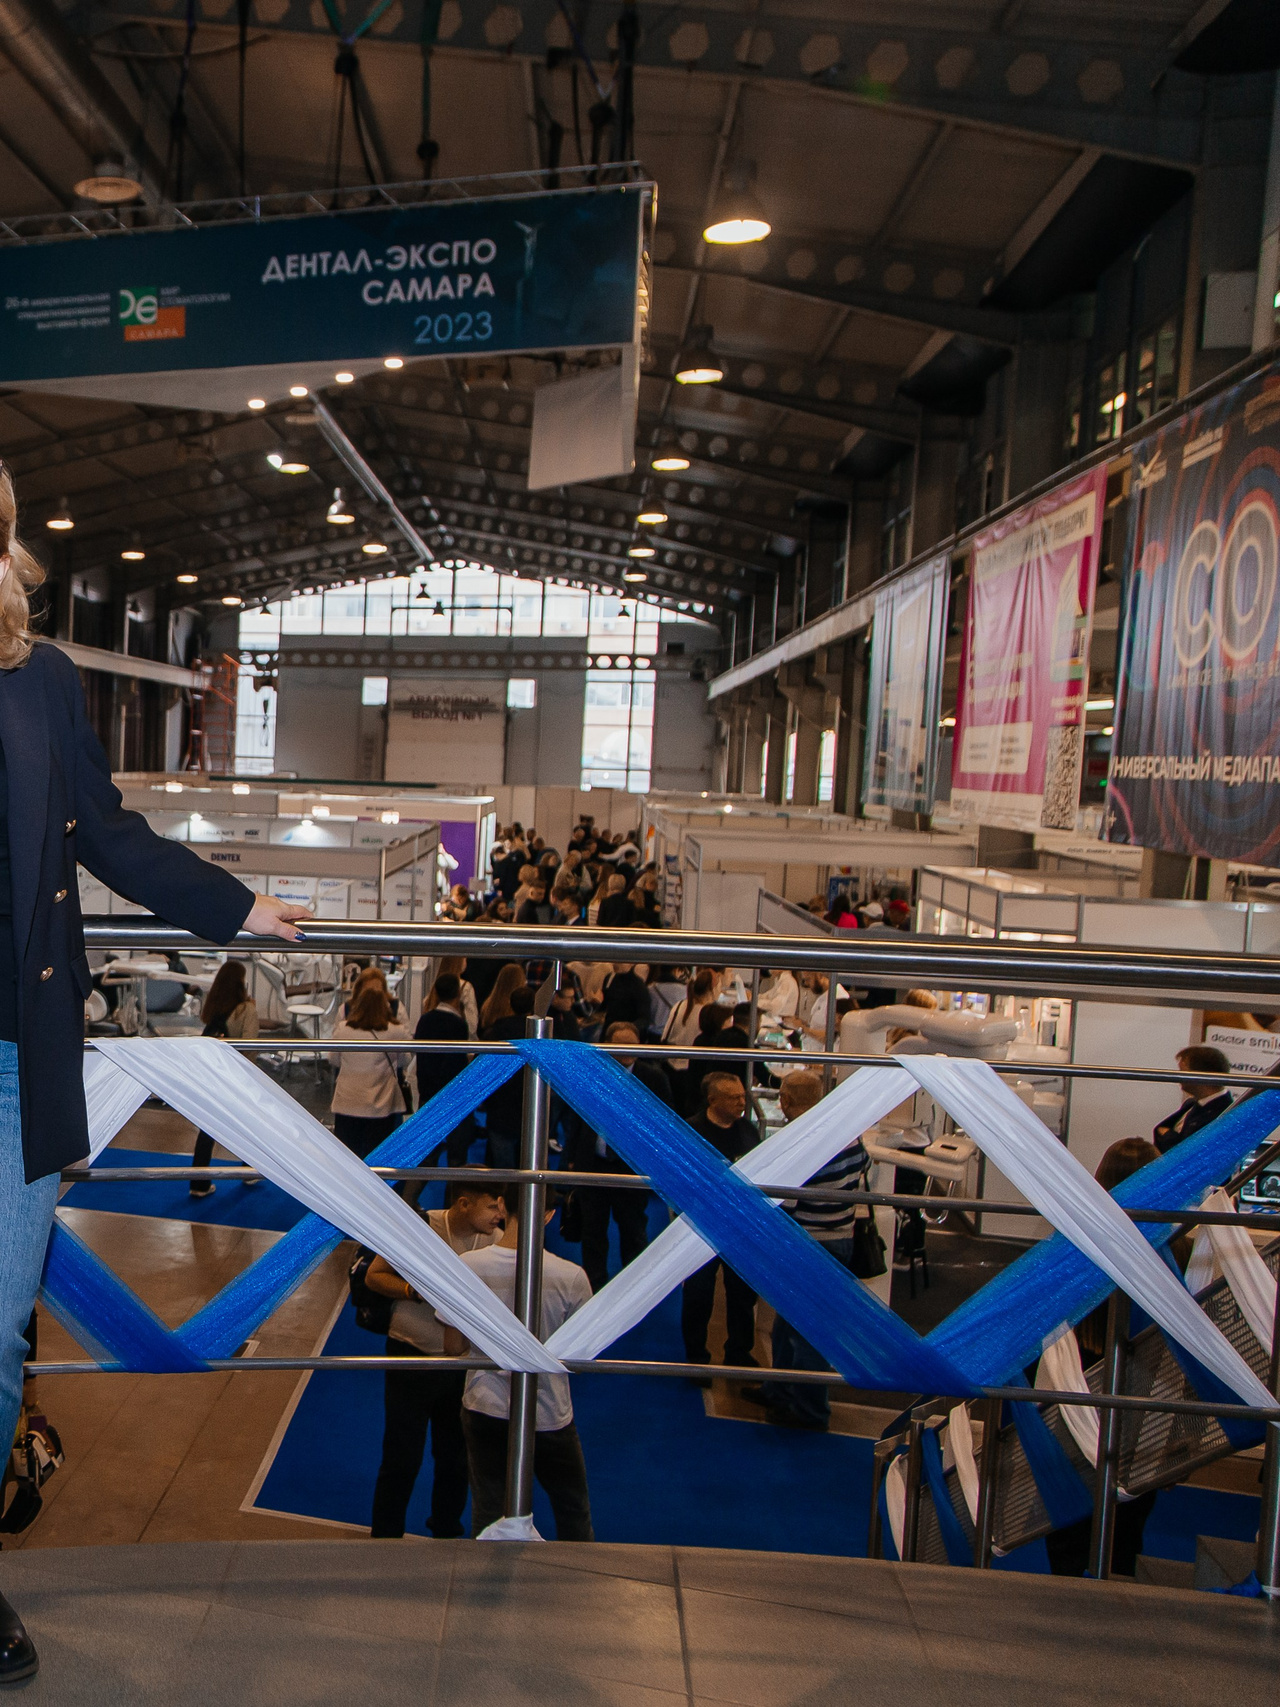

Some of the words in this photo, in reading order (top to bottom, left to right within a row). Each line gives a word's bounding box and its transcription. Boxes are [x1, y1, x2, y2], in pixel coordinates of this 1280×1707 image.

[261, 238, 496, 284] ДЕНТАЛ-ЭКСПО
[362, 272, 495, 305] САМАРА
[414, 311, 493, 344] 2023
[210, 852, 241, 862] DENTEX
[1211, 1033, 1246, 1045] doctor
